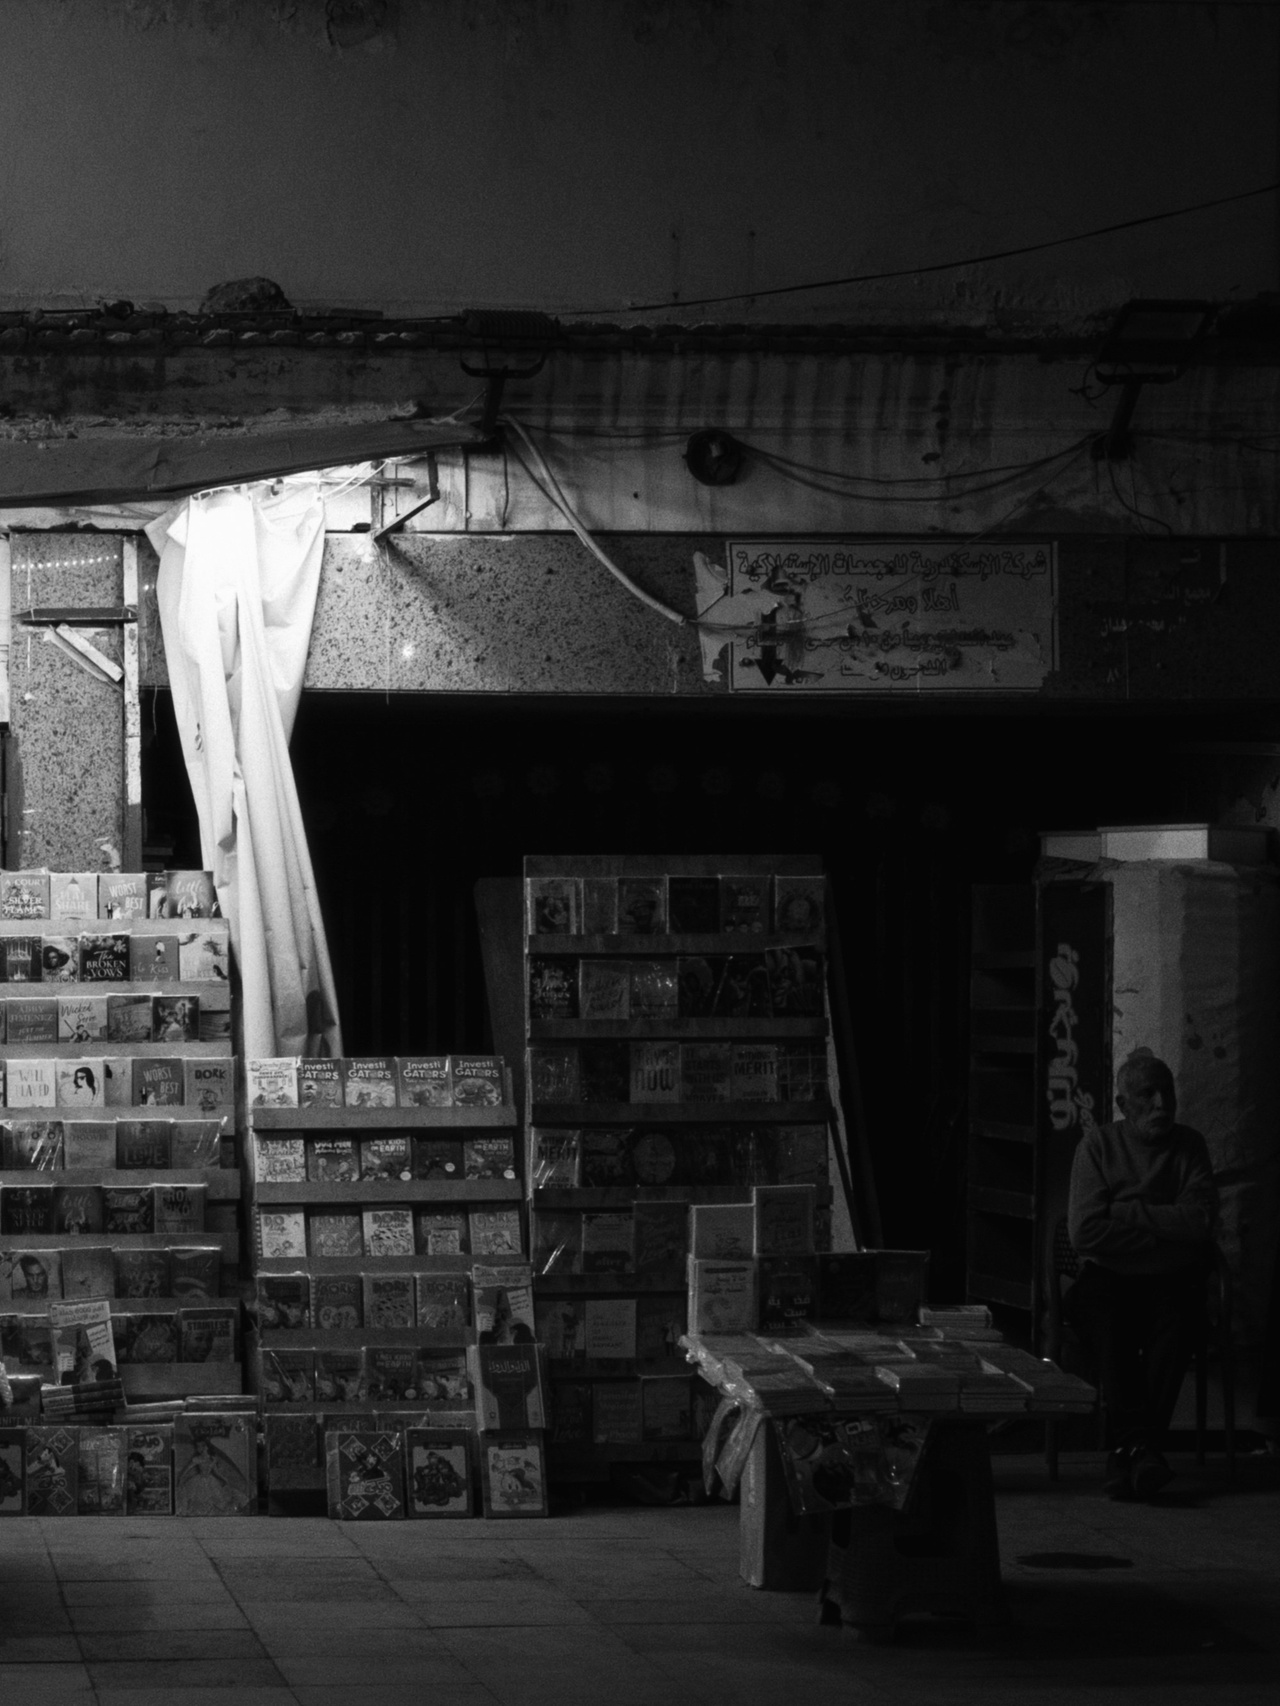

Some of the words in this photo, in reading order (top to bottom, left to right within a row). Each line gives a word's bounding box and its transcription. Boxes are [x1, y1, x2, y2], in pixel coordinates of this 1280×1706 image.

[911, 551, 1001, 583] الإسكندرية
[1003, 550, 1047, 580] شركة
[4, 878, 12, 887] A
[15, 877, 46, 887] COURT
[109, 882, 137, 898] WORST
[55, 900, 91, 912] SHARE
[125, 896, 144, 910] BEST
[93, 950, 115, 961] The
[86, 959, 127, 969] BROKEN
[91, 967, 124, 978] VOWS
[60, 1002, 93, 1017] Wicked
[9, 1013, 54, 1023] JIMENEZ
[76, 1013, 97, 1025] Serve
[684, 1059, 721, 1071] STARTS
[732, 1060, 776, 1076] MERIT
[143, 1067, 173, 1083] WORST
[194, 1068, 227, 1080] DORK
[159, 1081, 180, 1095] BEST
[371, 1281, 410, 1294] DORK
